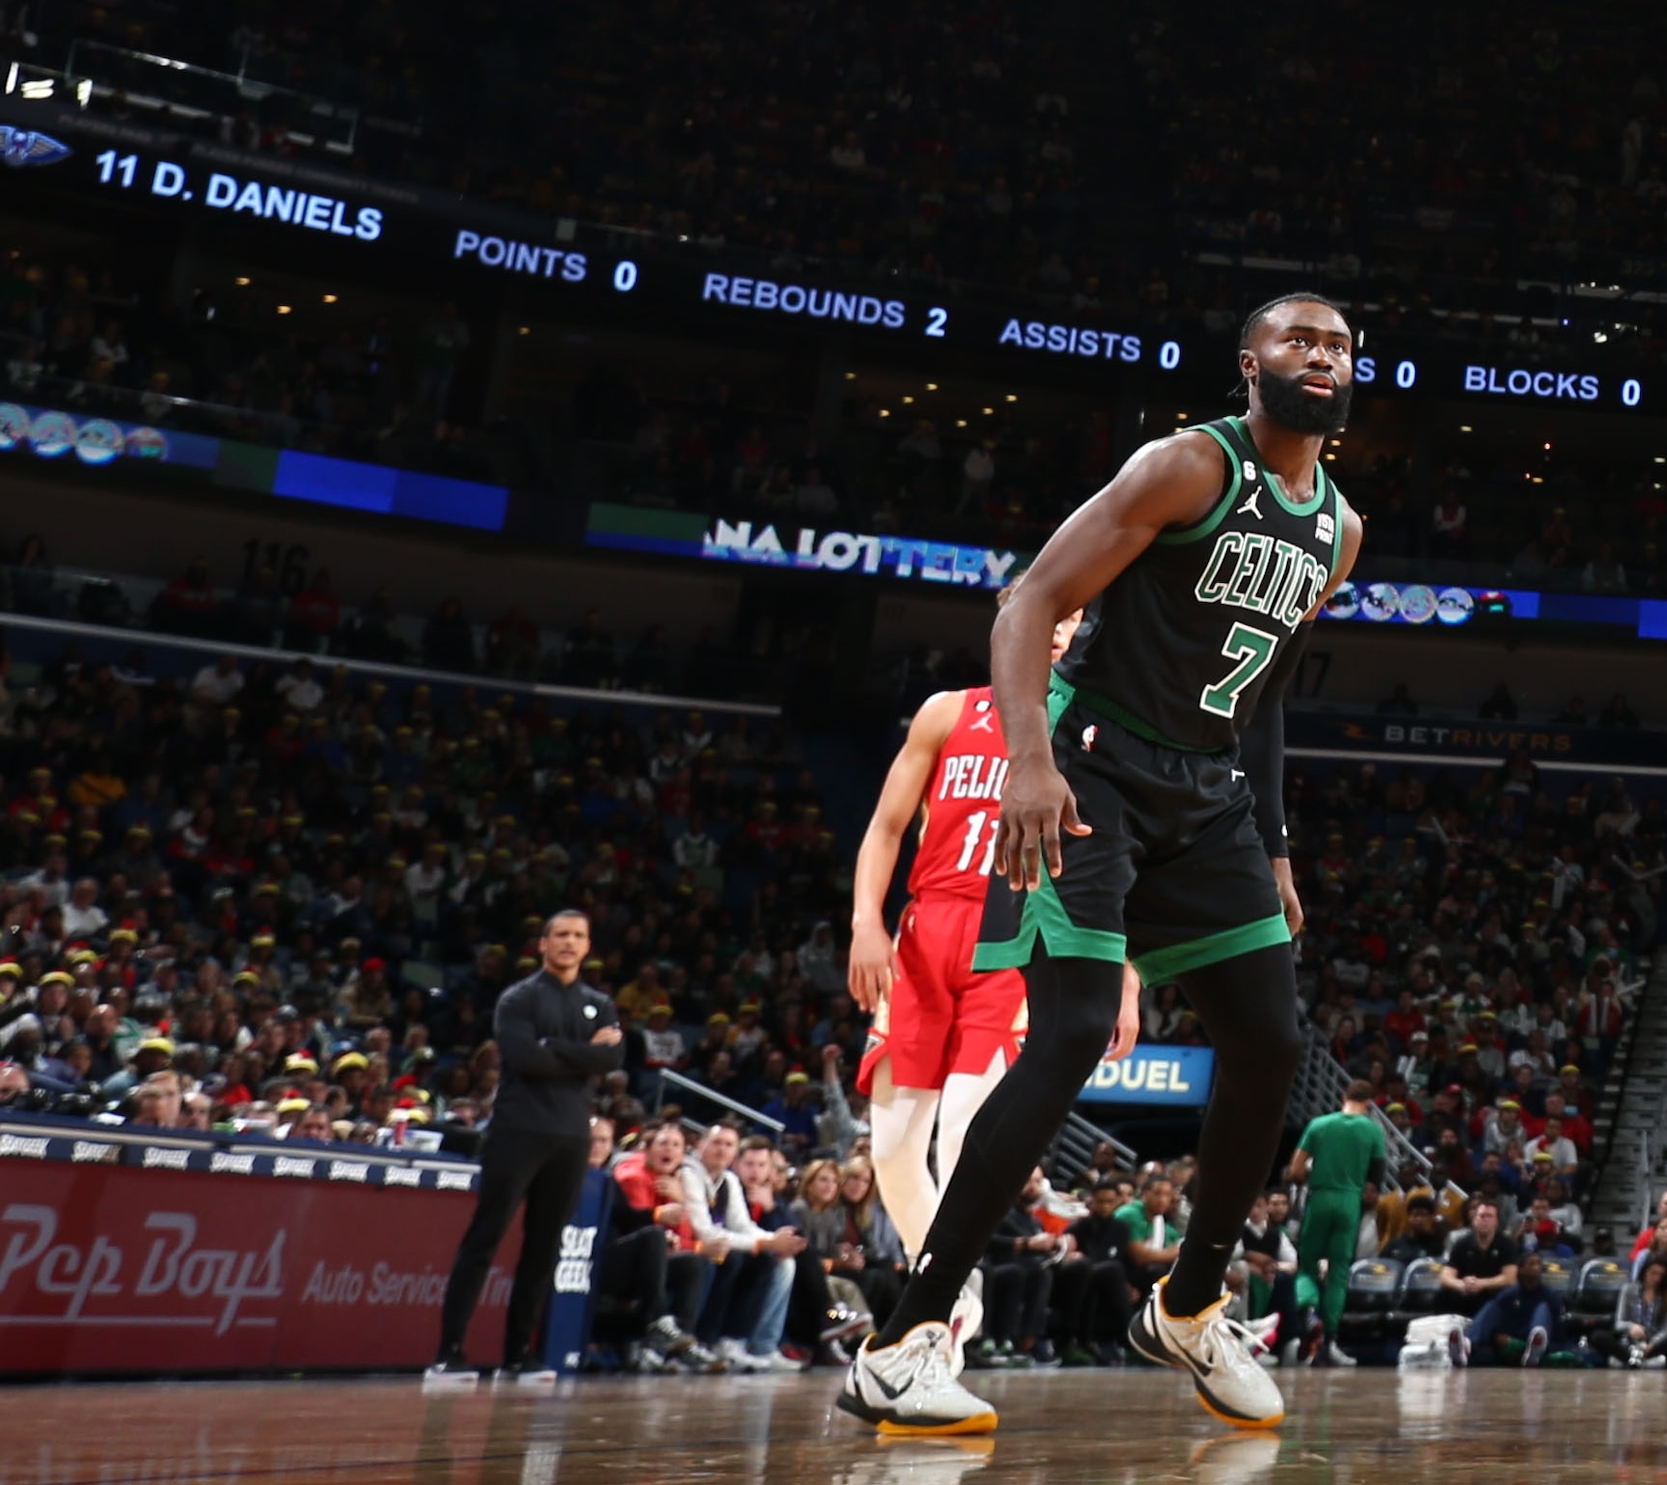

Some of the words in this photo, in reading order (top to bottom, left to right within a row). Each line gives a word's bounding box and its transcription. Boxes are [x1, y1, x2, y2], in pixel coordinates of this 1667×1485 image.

[95, 148, 139, 189] 11
[151, 160, 195, 203] D.
[204, 172, 384, 242] DANIELS
[453, 229, 588, 283] POINTS
[613, 260, 638, 292] 0
[702, 271, 906, 329] REBOUNDS
[925, 307, 948, 338] 2
[999, 318, 1142, 364] ASSISTS
[1159, 340, 1181, 370] 0
[1396, 360, 1417, 388] 0
[1464, 365, 1600, 400] BLOCKS
[1621, 378, 1641, 407] 0
[1242, 460, 1257, 481] 6
[702, 517, 791, 565] NA
[796, 527, 1017, 589] LOTTERY
[1194, 531, 1329, 635] CELTICS
[1200, 621, 1279, 719] 7
[1383, 723, 1573, 753] BETRIVERS
[938, 754, 1010, 801] PELIC
[1096, 1059, 1190, 1094] DUEL
[0, 1202, 124, 1322] Pep
[134, 1210, 288, 1337] Boys
[302, 1260, 363, 1306] Auto
